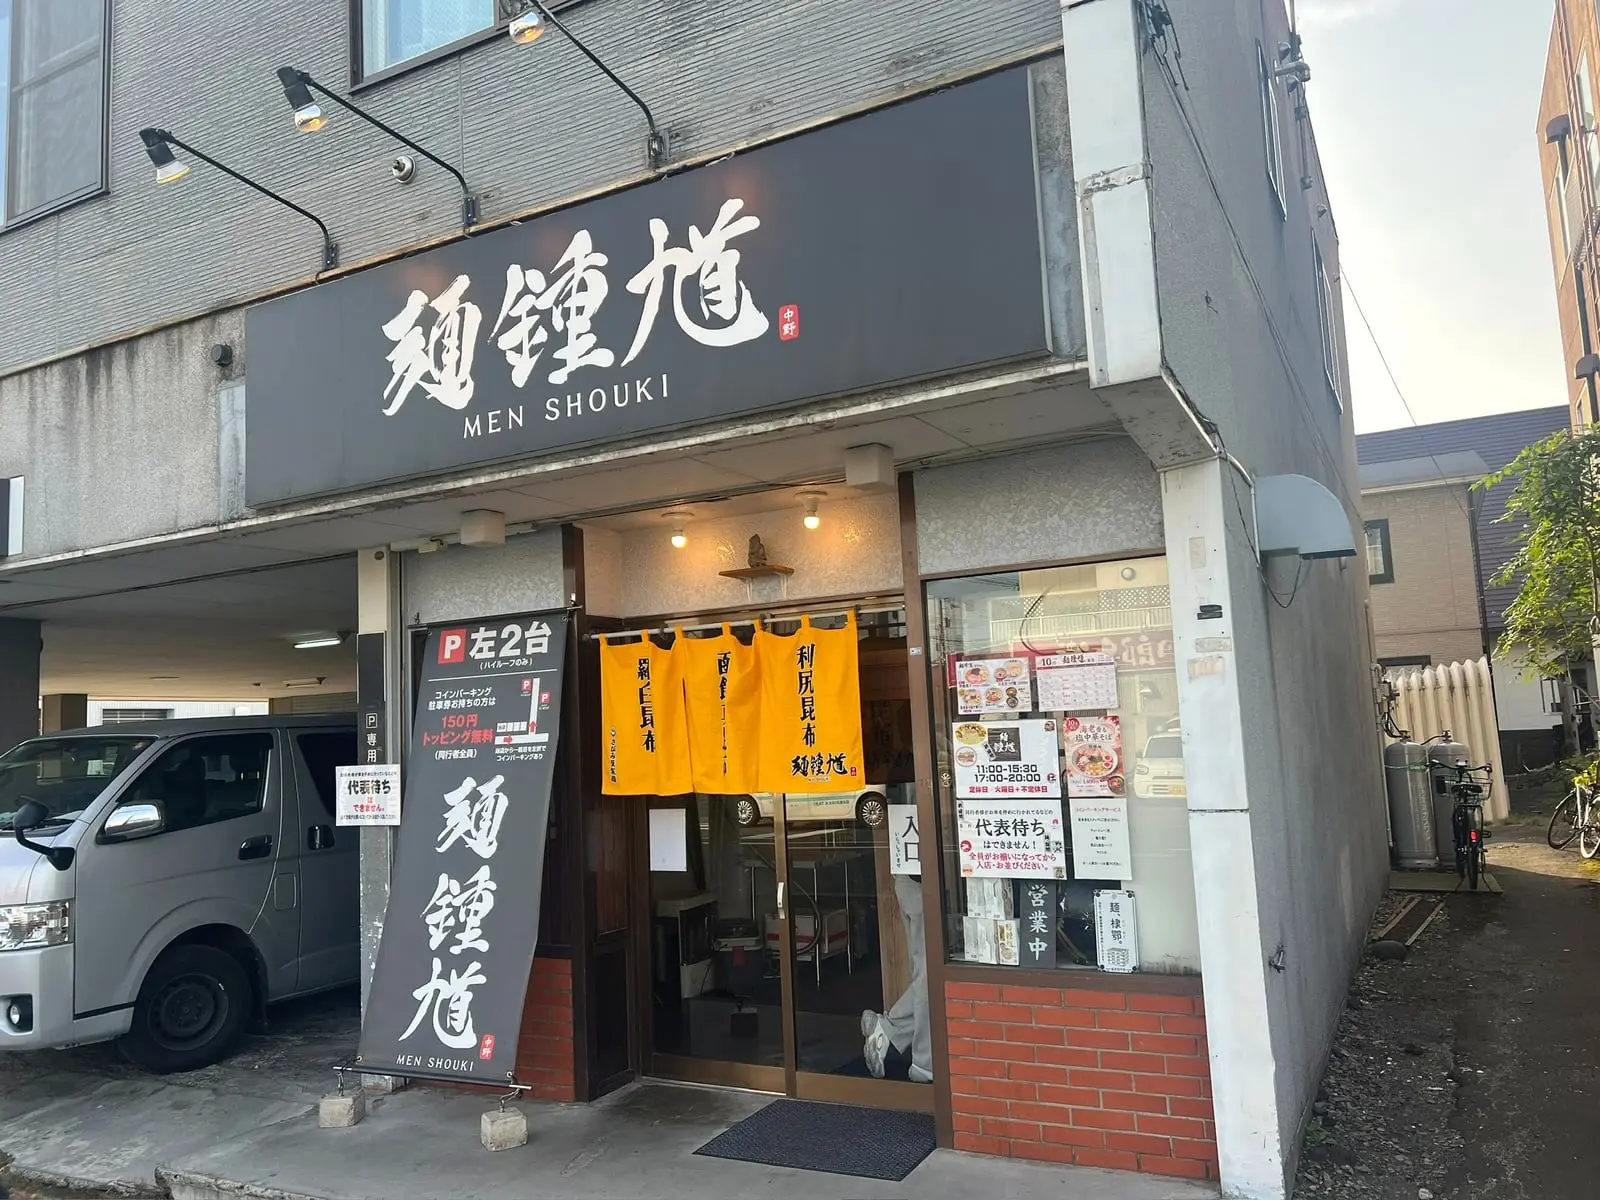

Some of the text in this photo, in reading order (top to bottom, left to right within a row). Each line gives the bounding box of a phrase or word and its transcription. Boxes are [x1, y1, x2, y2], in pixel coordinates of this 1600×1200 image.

[782, 307, 797, 336] 中野
[462, 374, 670, 440] MEN SHOUKI
[444, 621, 552, 660] P 左2台
[435, 686, 492, 699] コインパーキング
[796, 643, 816, 748] 利尻昆布
[428, 697, 497, 711] 駐車券お持ちの方は
[442, 713, 478, 729] 150円
[423, 728, 494, 747] トッピング無料
[974, 773, 1041, 783] 17:00-20:00
[976, 764, 1038, 774] 11:00-15:30
[348, 779, 392, 796] 代表待ち
[975, 818, 1046, 837] 代表待ち
[902, 815, 920, 863] 入口
[1027, 883, 1049, 961] 営業中
[396, 1054, 474, 1072] MEN SHOUKI
